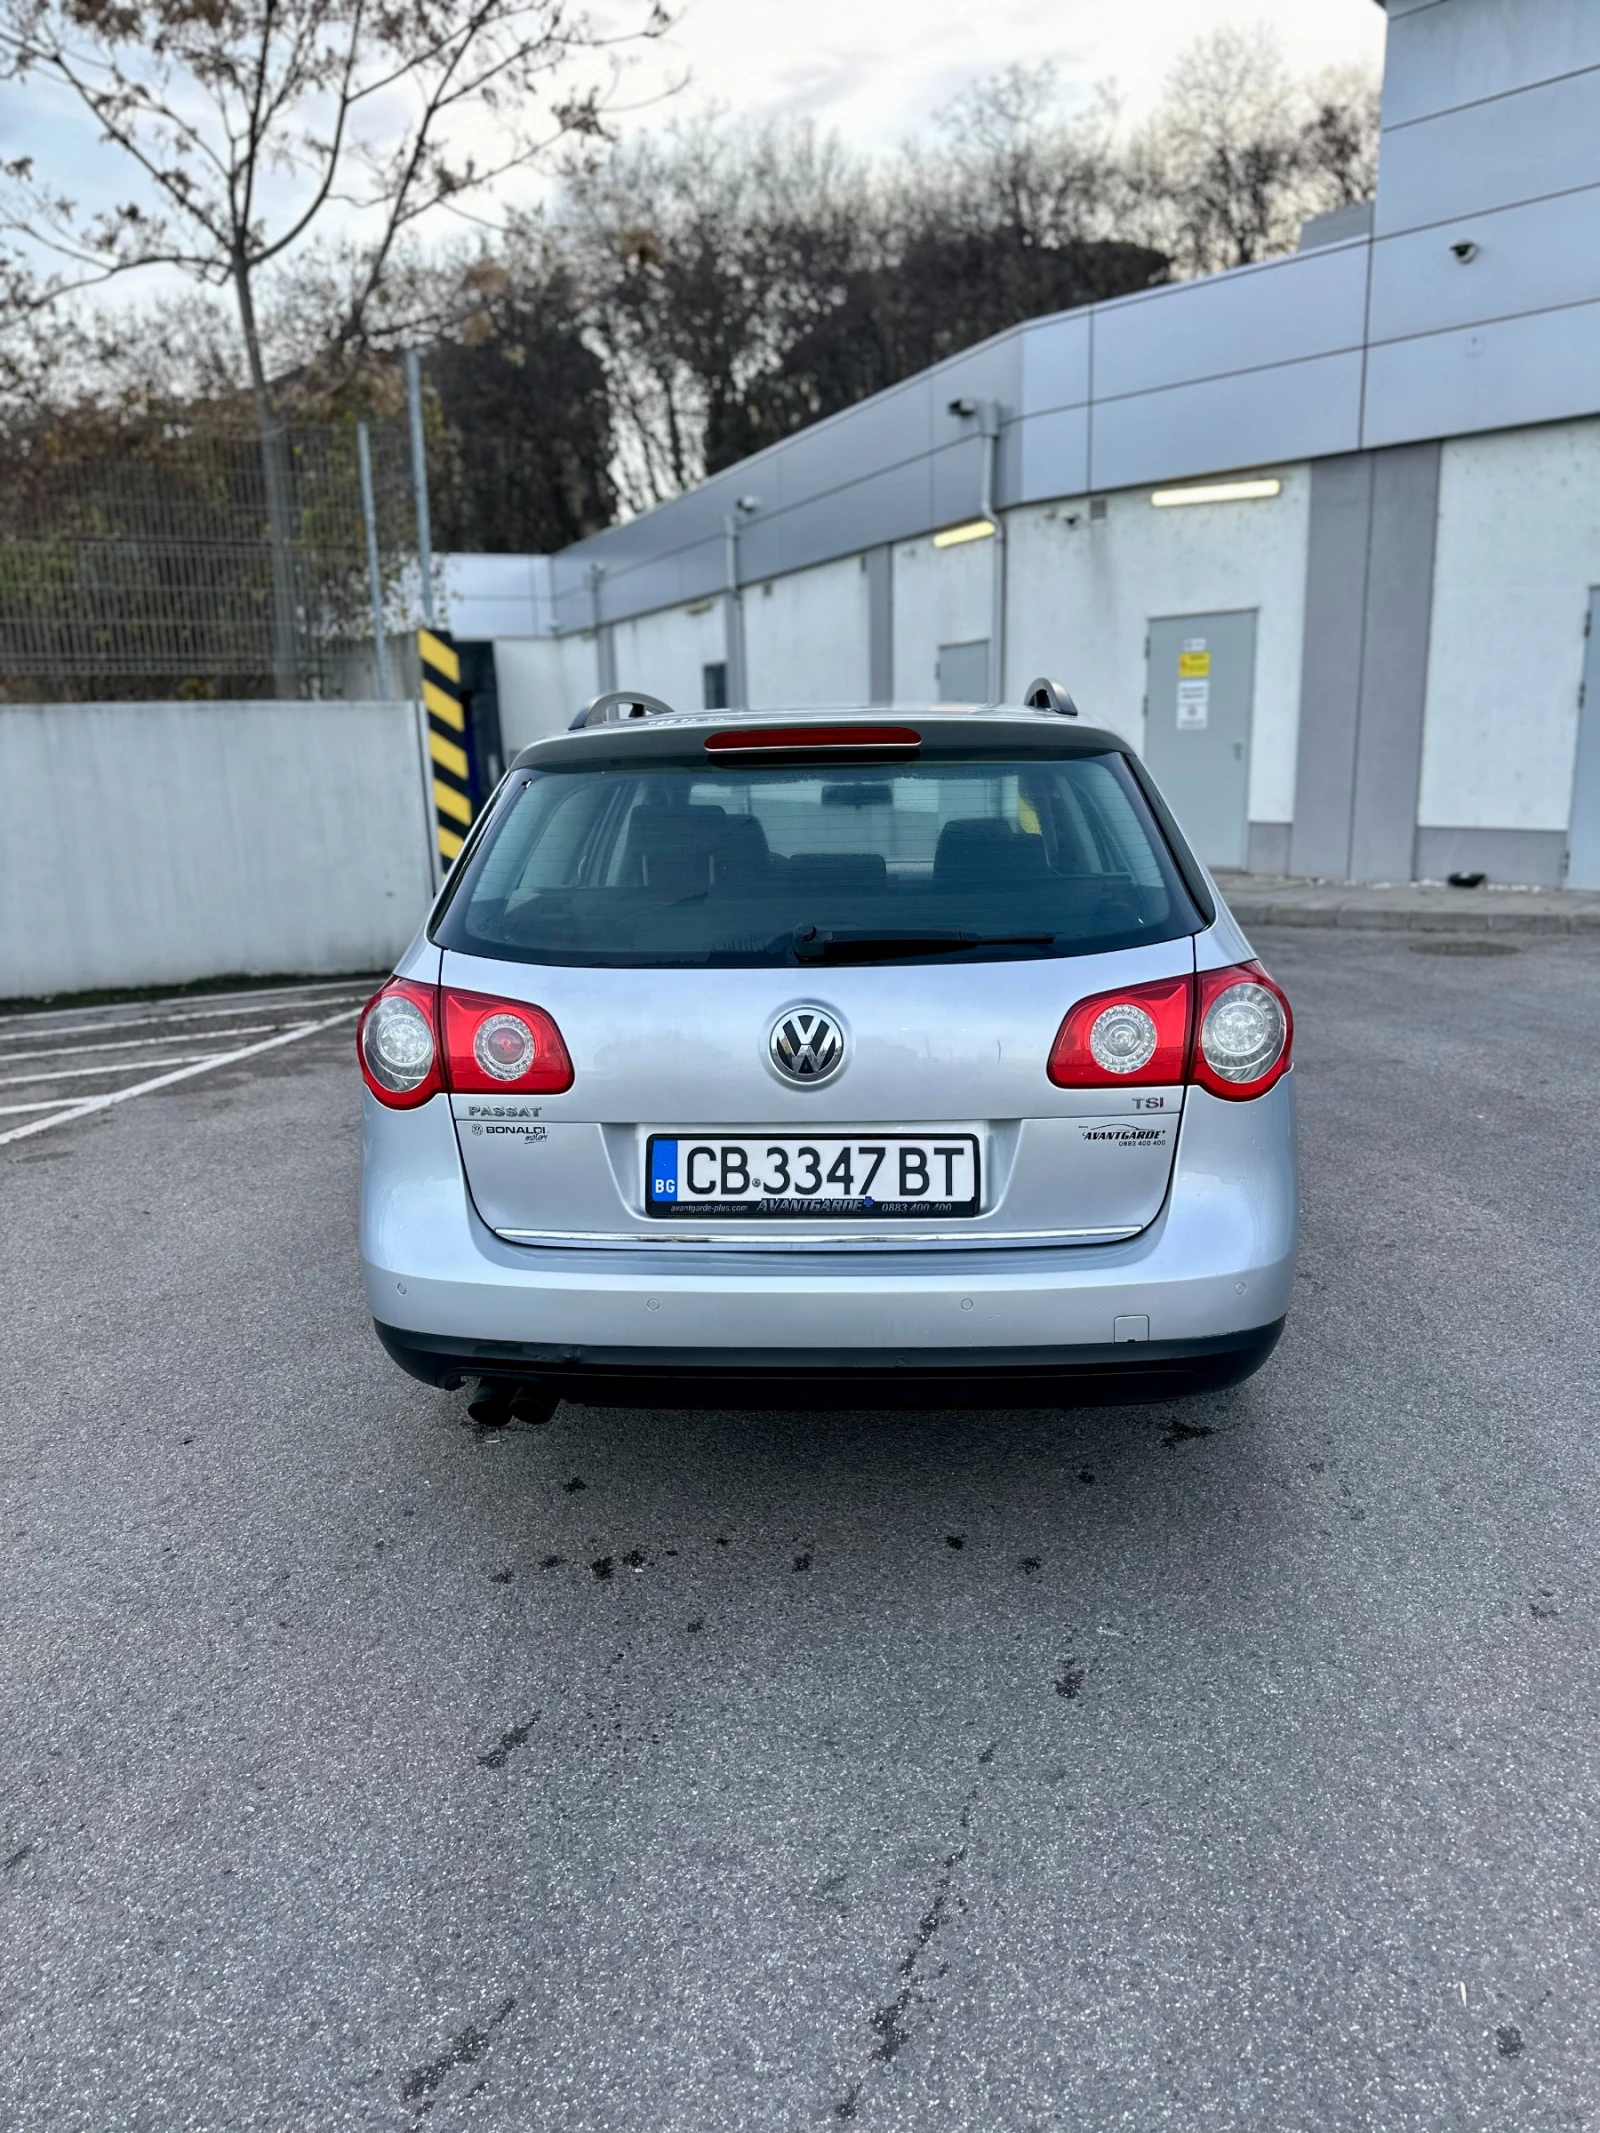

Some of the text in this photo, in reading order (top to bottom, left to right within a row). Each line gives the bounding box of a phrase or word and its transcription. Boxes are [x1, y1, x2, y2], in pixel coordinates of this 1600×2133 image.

[1132, 1097, 1164, 1109] TSI
[468, 1105, 542, 1117] PASSAT
[486, 1126, 546, 1135] BONALDI
[687, 1146, 965, 1196] CB 3347 BT
[655, 1179, 675, 1194] BG
[670, 1203, 748, 1214] avantgarde-plus.com
[881, 1202, 952, 1213] 0883 400 400
